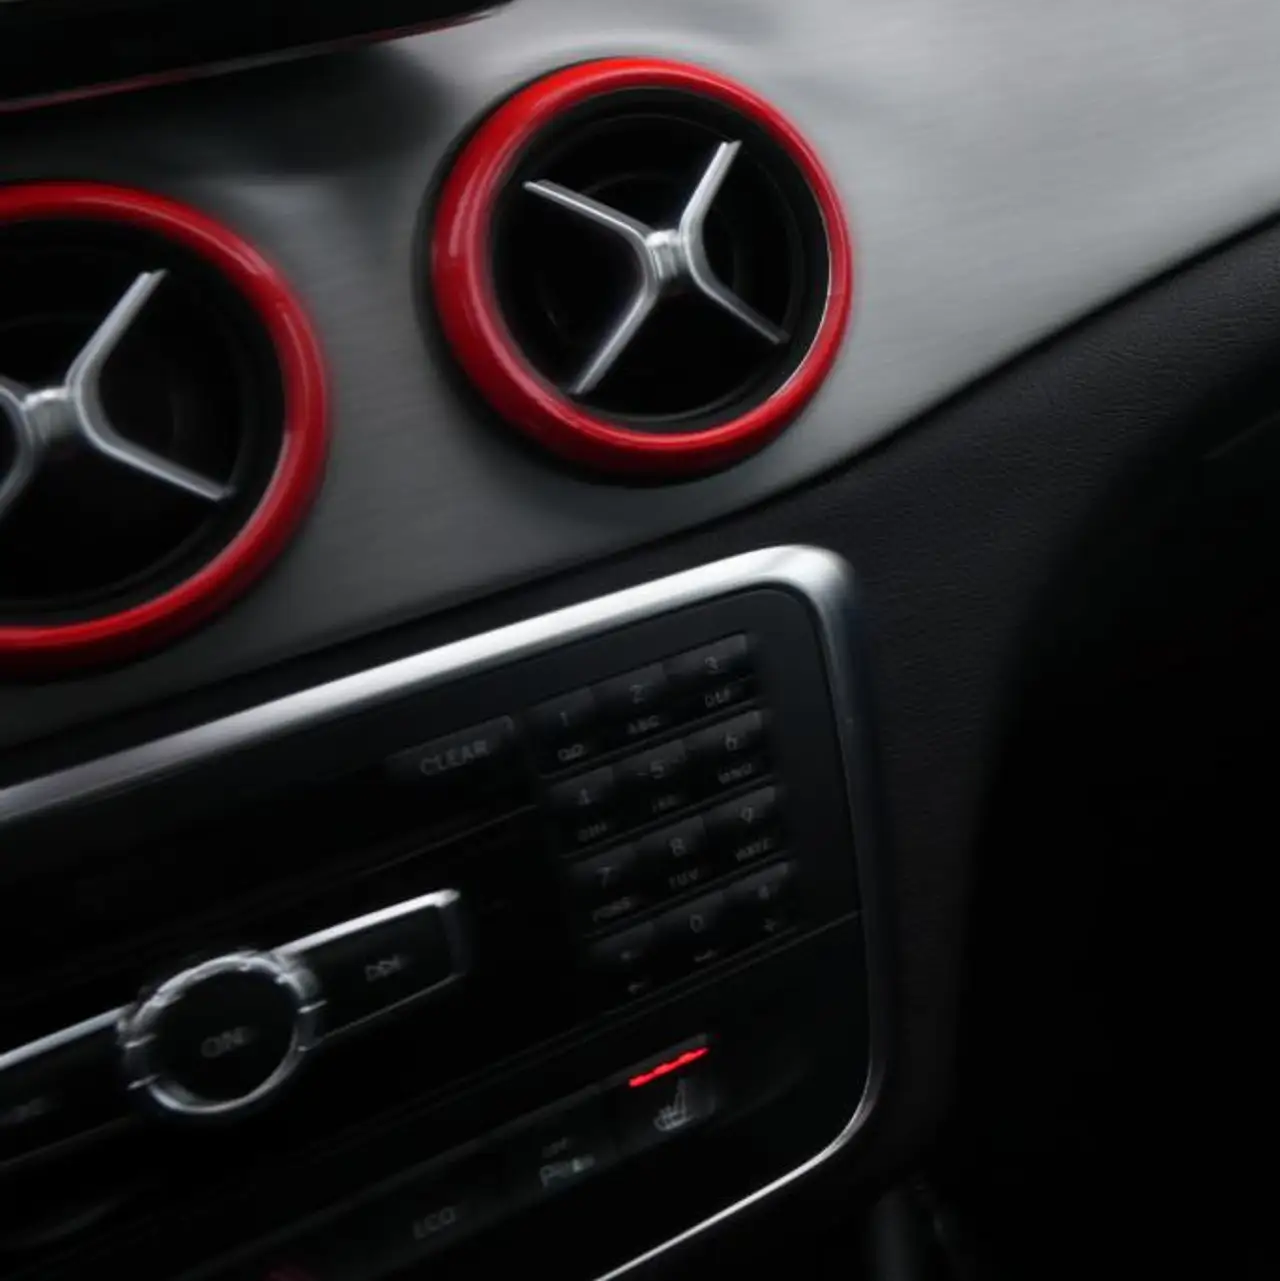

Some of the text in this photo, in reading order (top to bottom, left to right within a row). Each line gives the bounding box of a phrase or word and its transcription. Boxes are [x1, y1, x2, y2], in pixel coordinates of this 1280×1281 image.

[628, 683, 646, 705] 2
[420, 739, 488, 776] CLEAR
[649, 758, 666, 779] 5
[668, 836, 686, 858] 8
[595, 862, 613, 889] 7
[688, 912, 705, 934] 0
